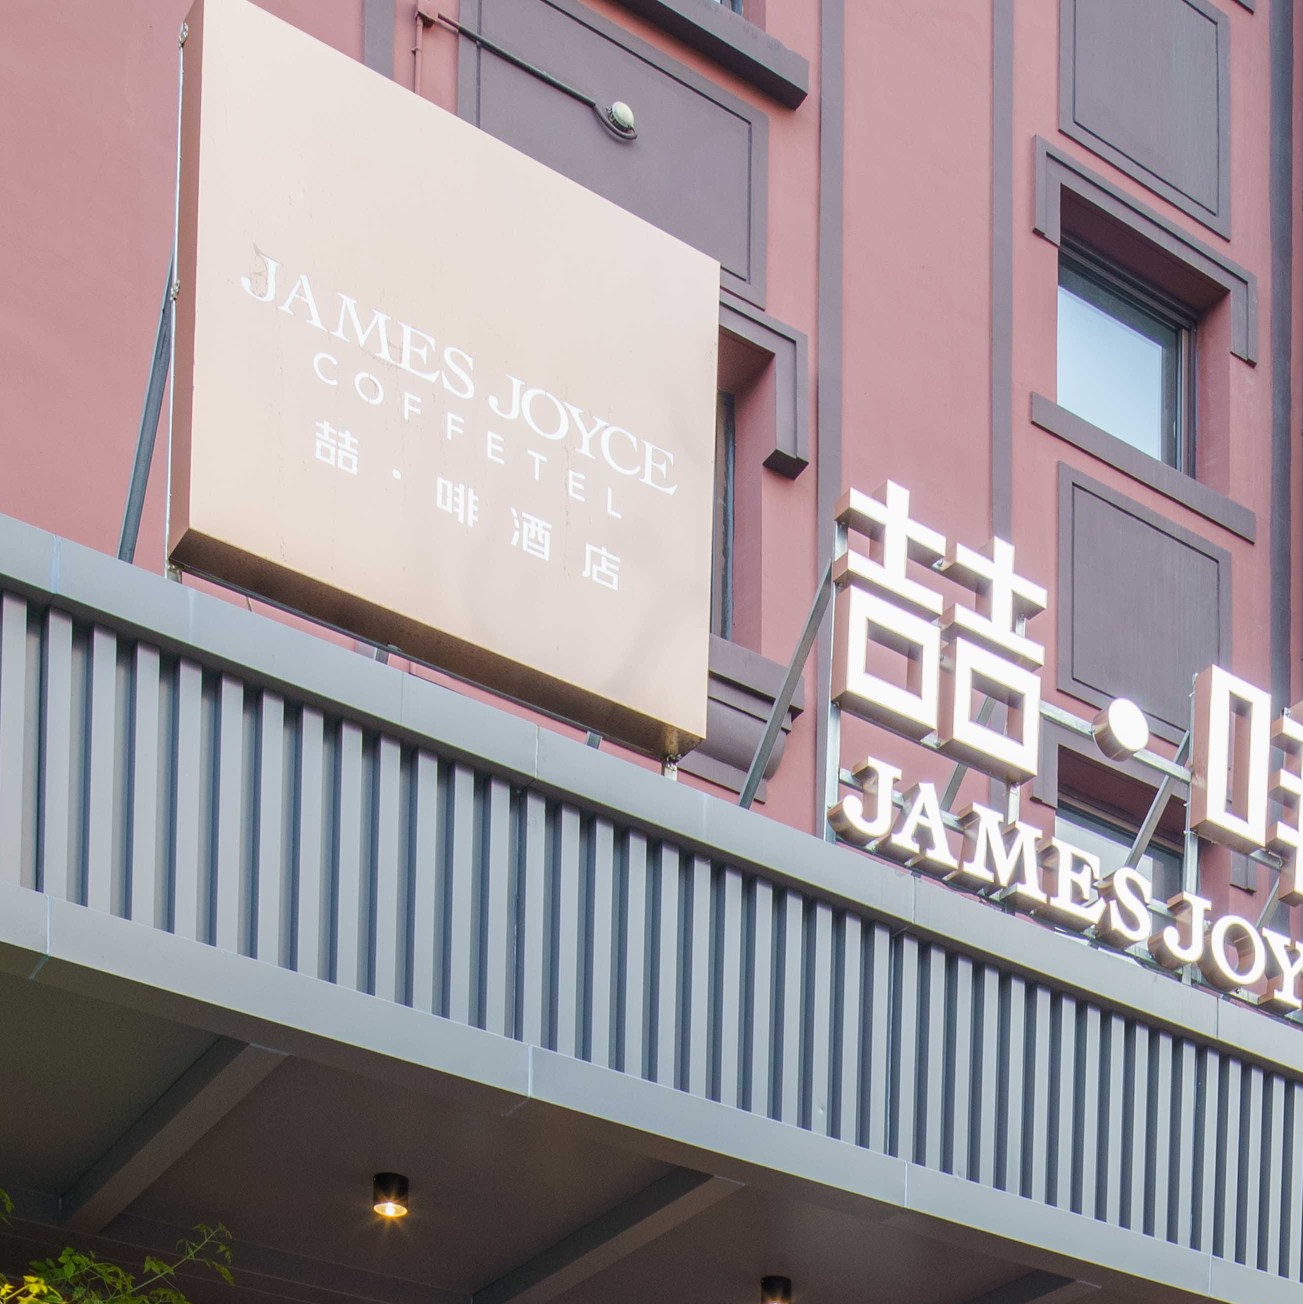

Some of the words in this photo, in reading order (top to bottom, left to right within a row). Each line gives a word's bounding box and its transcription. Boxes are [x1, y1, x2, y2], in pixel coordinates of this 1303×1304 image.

[241, 255, 474, 399] JAMES
[489, 374, 679, 495] JOYCE
[313, 353, 621, 519] COFFETEL
[839, 757, 1152, 946] JAMES
